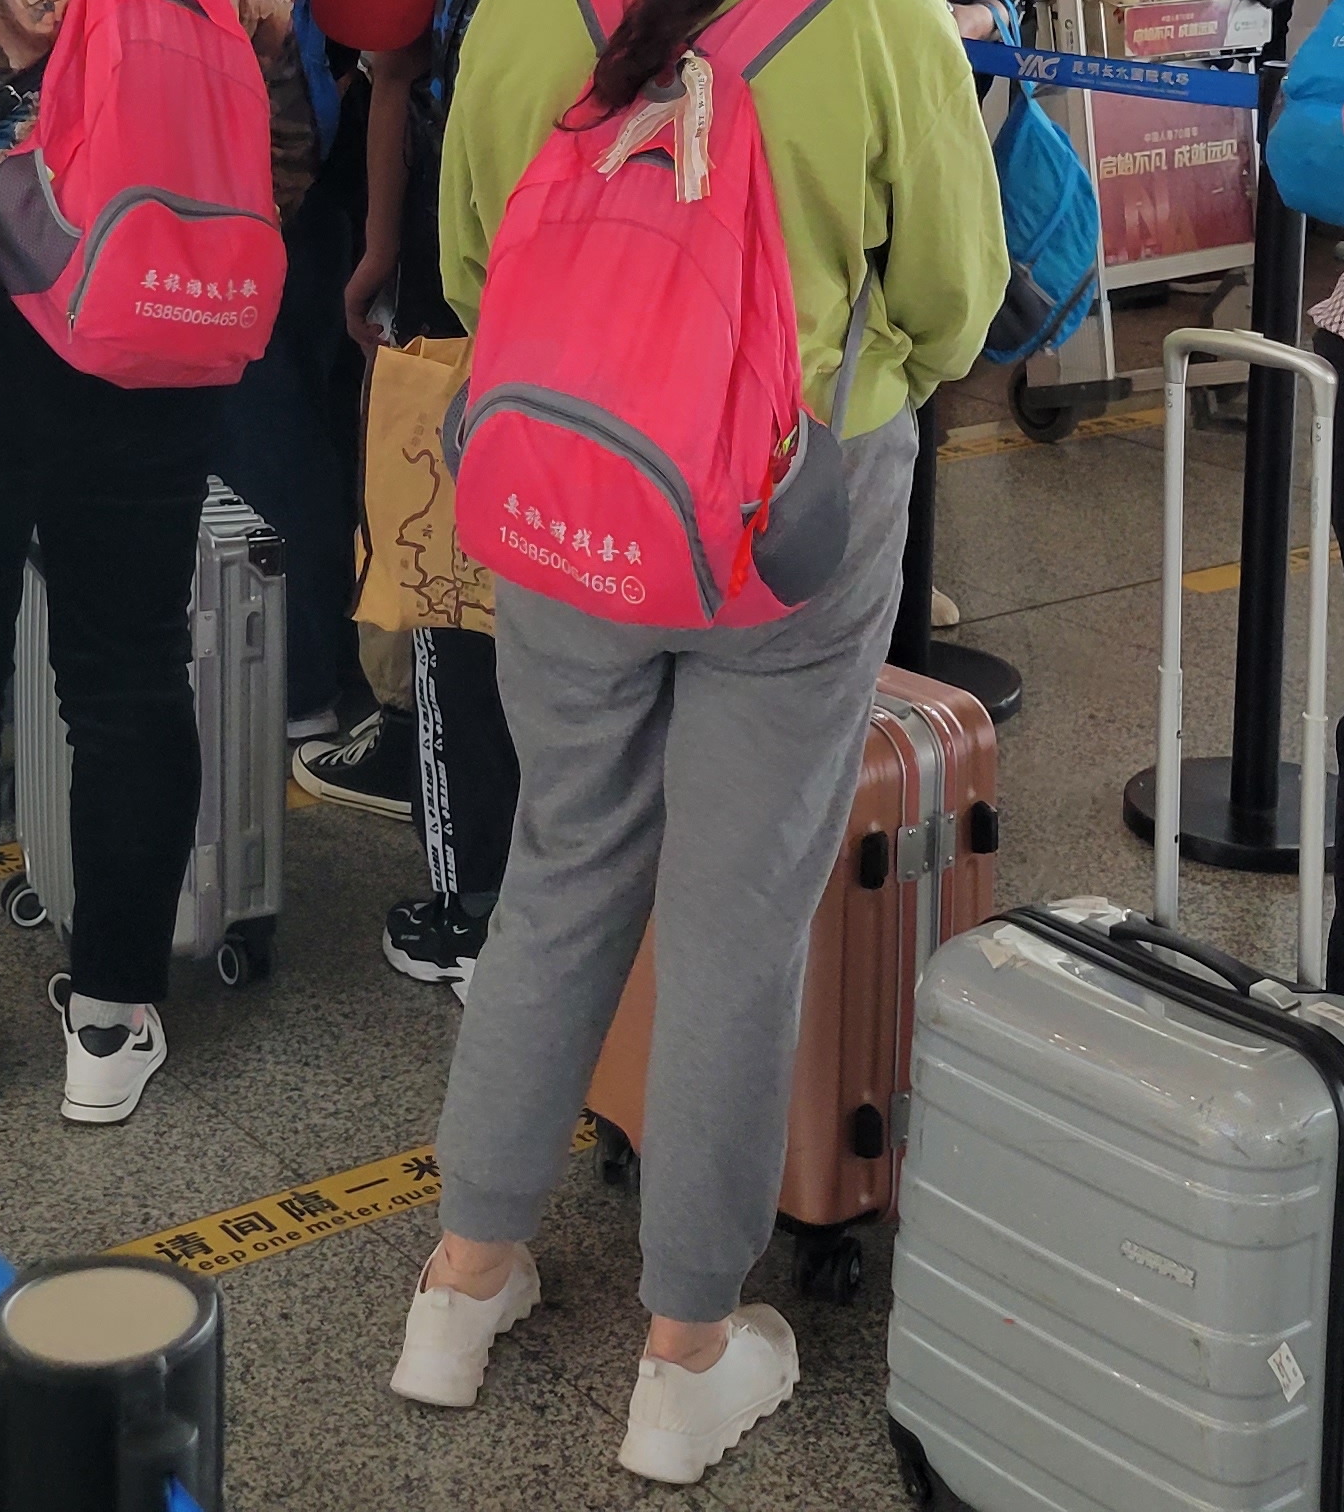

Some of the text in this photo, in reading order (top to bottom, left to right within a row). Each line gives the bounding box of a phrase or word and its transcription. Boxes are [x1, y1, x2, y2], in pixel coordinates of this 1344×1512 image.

[1072, 60, 1190, 86] 昆明长水国际机场
[1100, 139, 1238, 180] 启始不凡 成就远见
[134, 300, 238, 326] 15385006465
[499, 526, 617, 595] 15385006465
[154, 1155, 441, 1264] 请间隔一米
[253, 1229, 302, 1254] one
